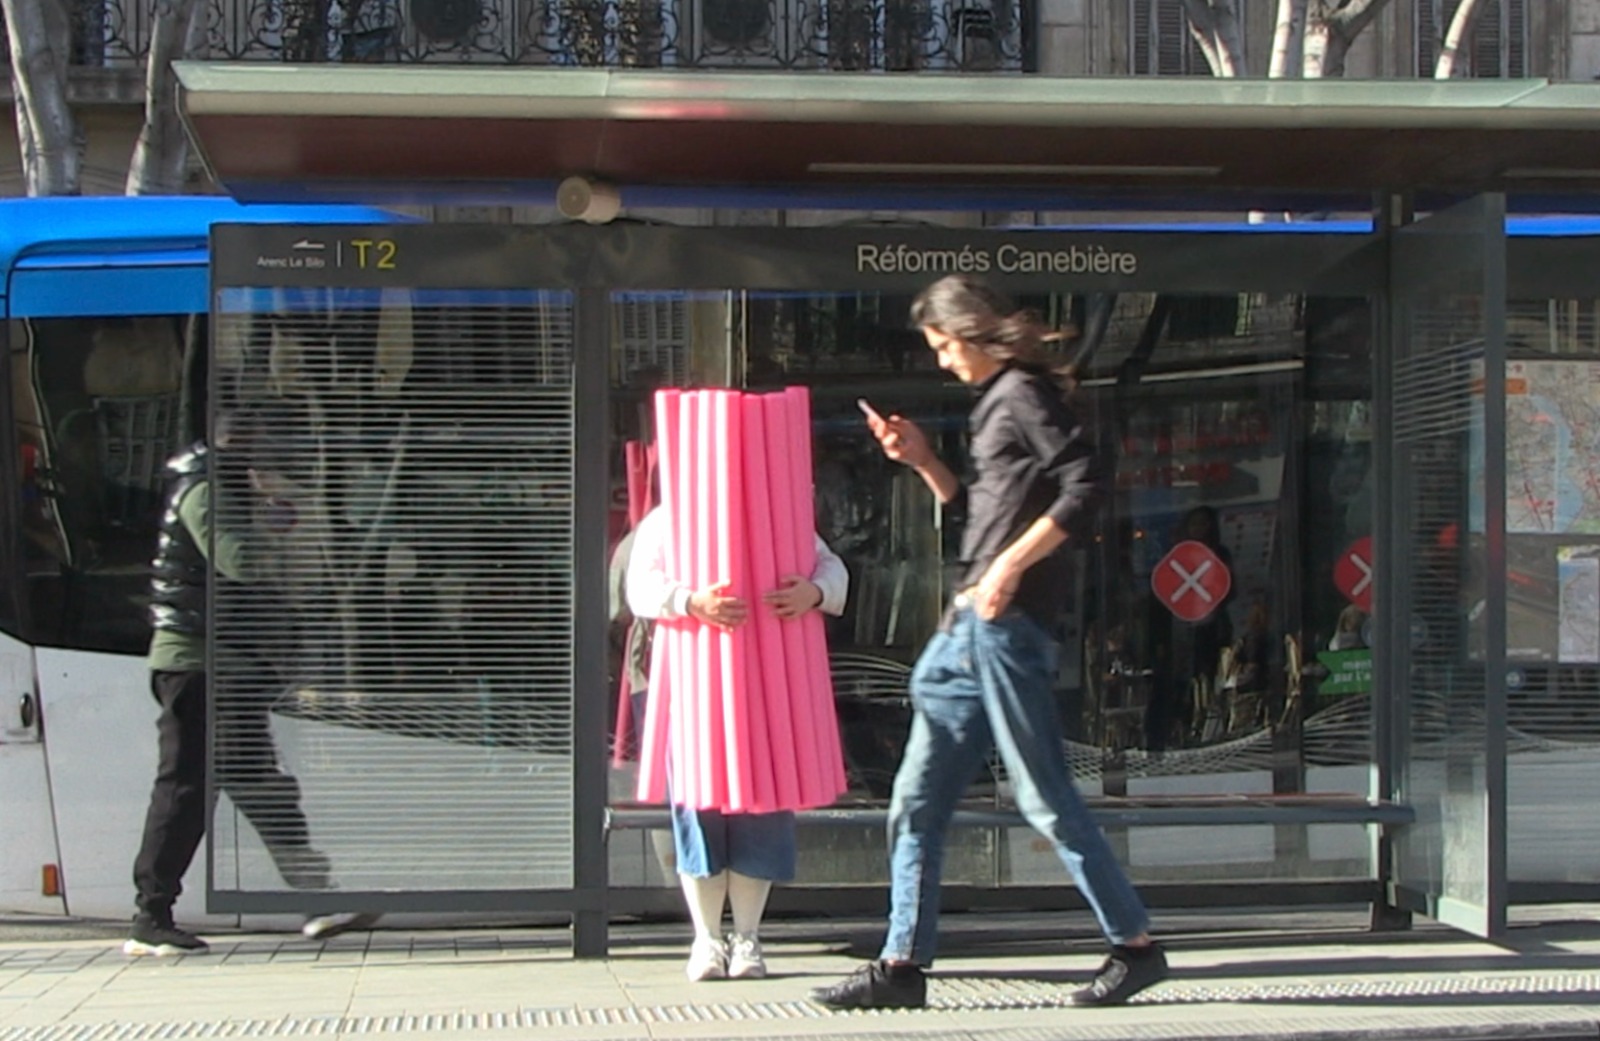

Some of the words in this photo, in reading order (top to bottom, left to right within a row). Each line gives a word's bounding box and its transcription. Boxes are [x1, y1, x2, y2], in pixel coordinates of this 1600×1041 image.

[289, 257, 303, 268] Le
[350, 239, 397, 269] T2
[857, 244, 991, 272] Réformés
[997, 244, 1137, 273] Canebière
